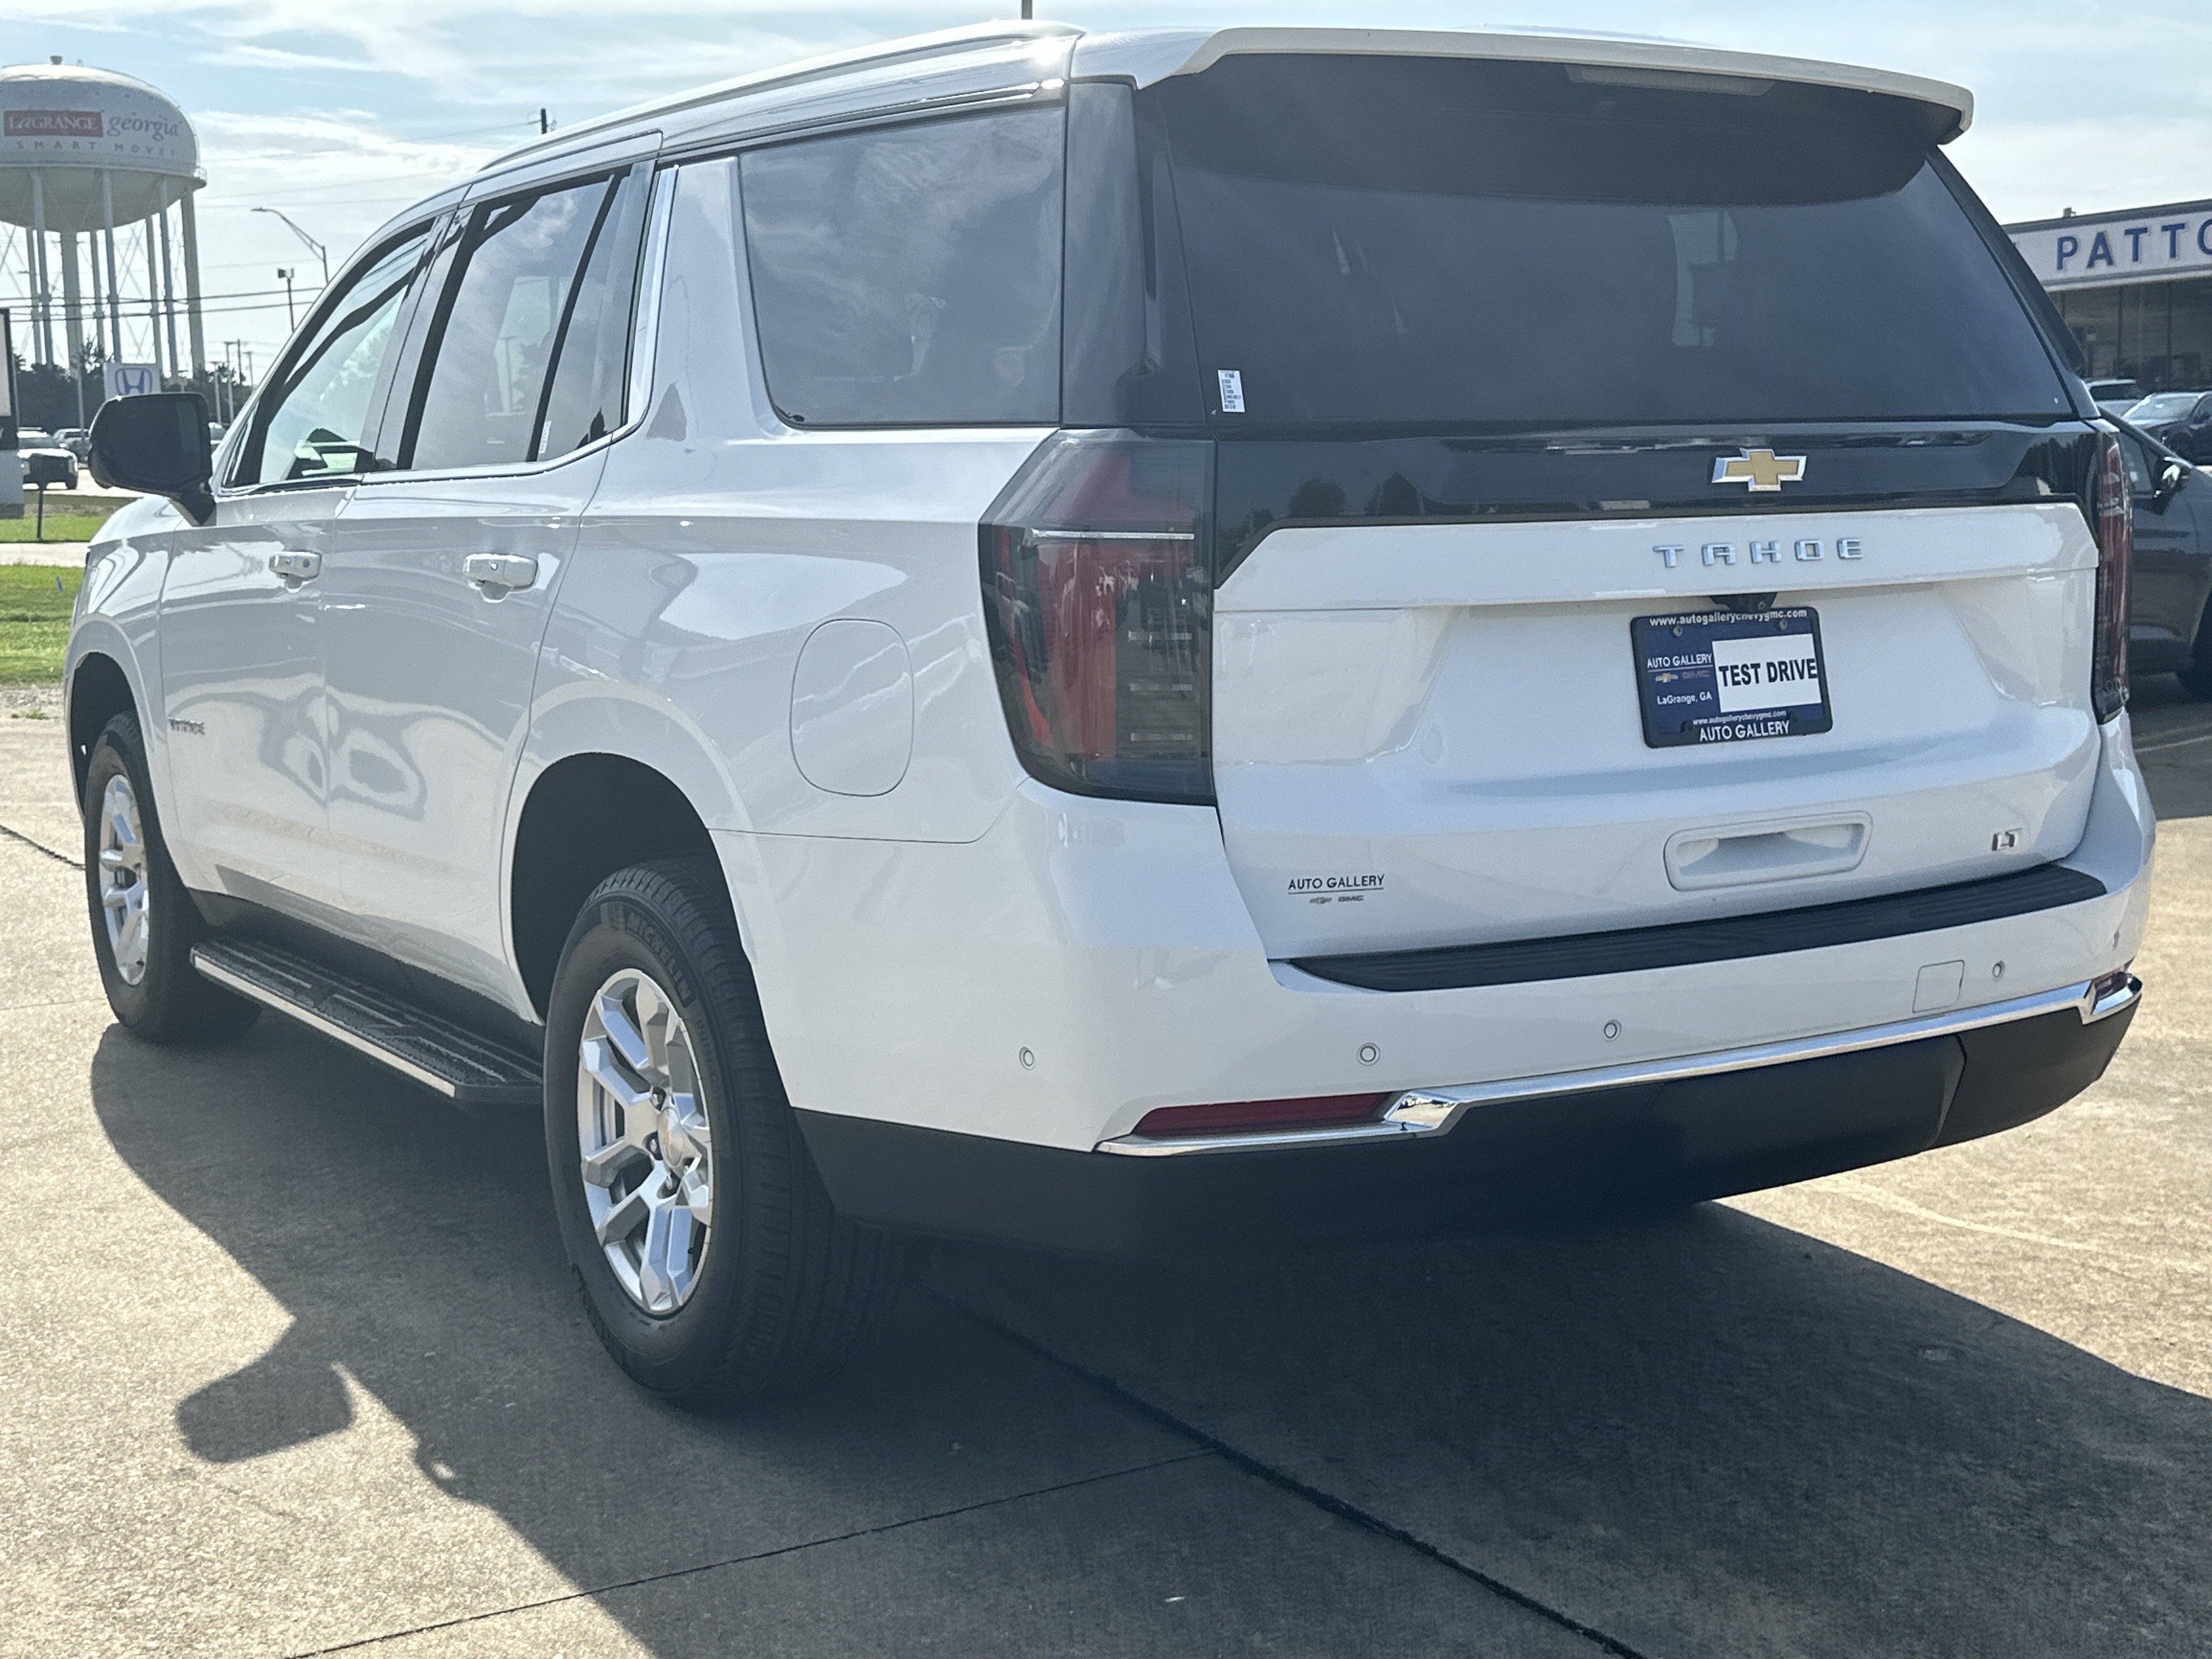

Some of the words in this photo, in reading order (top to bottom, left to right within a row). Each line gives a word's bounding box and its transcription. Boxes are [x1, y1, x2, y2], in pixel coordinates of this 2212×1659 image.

[106, 115, 178, 142] georgia
[1652, 538, 1863, 568] TAHOE
[1647, 657, 1671, 668] AUTO
[1672, 653, 1712, 666] GALLERY
[1718, 663, 1760, 687] TEST
[1766, 658, 1819, 683] DRIVE
[1699, 691, 1712, 701] GA
[1700, 725, 1733, 742] AUTO
[1735, 720, 1790, 739] GALLERY
[1991, 828, 2022, 851] LT
[1288, 878, 1323, 890] AUTO
[1327, 874, 1385, 888] GALLERY
[627, 912, 691, 1001] MICHELIN
